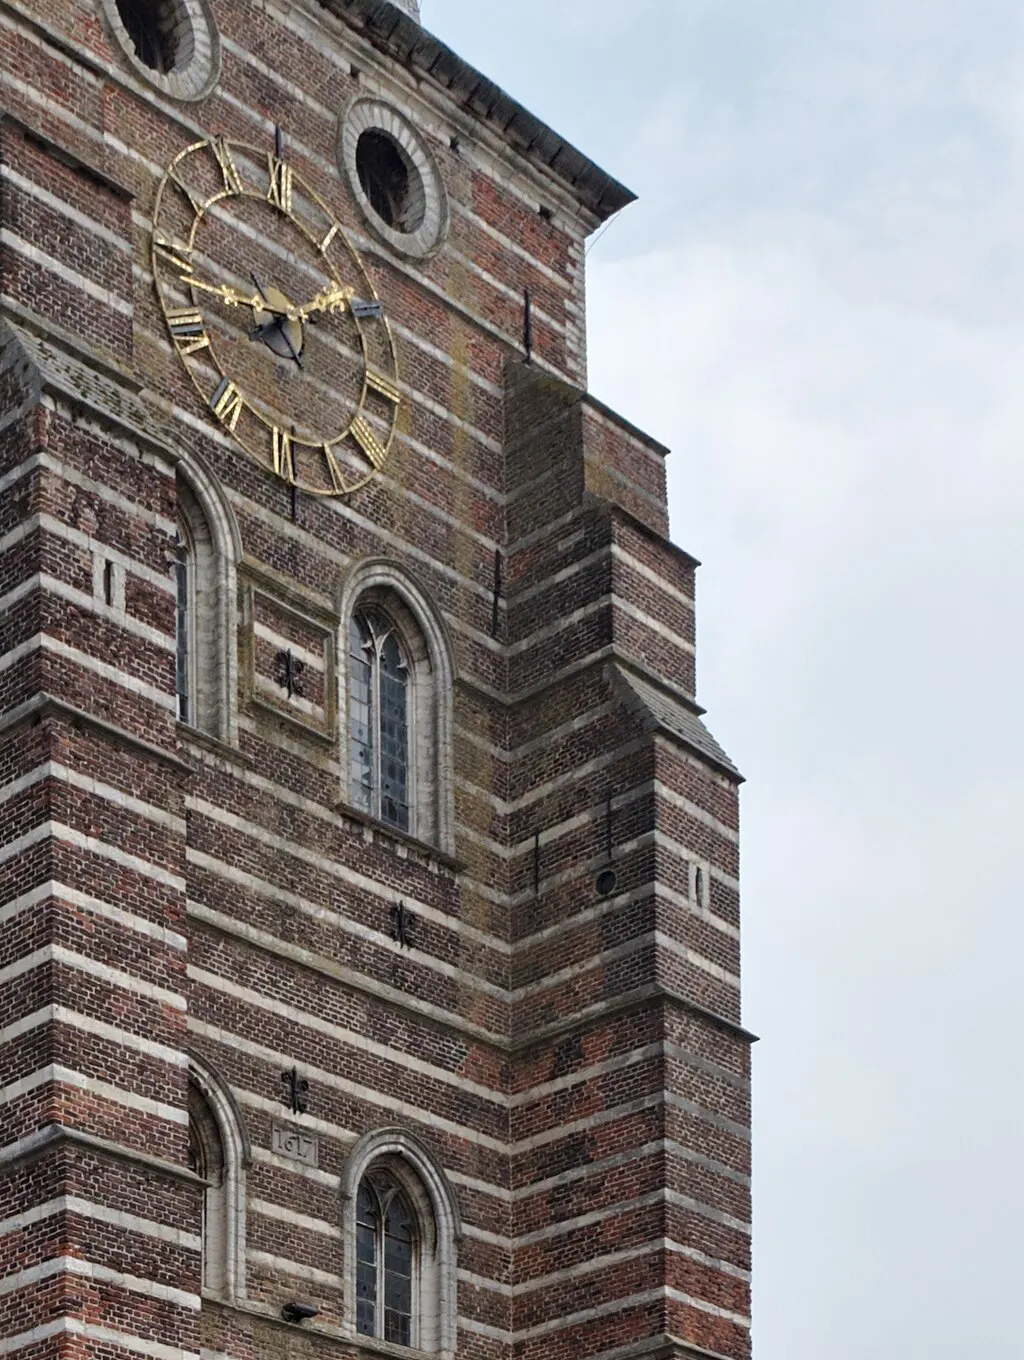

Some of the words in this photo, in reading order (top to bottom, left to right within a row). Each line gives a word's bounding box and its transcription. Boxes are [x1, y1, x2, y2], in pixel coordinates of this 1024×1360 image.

[267, 151, 292, 213] XII
[209, 375, 243, 431] VII
[273, 1128, 314, 1158] 1617
